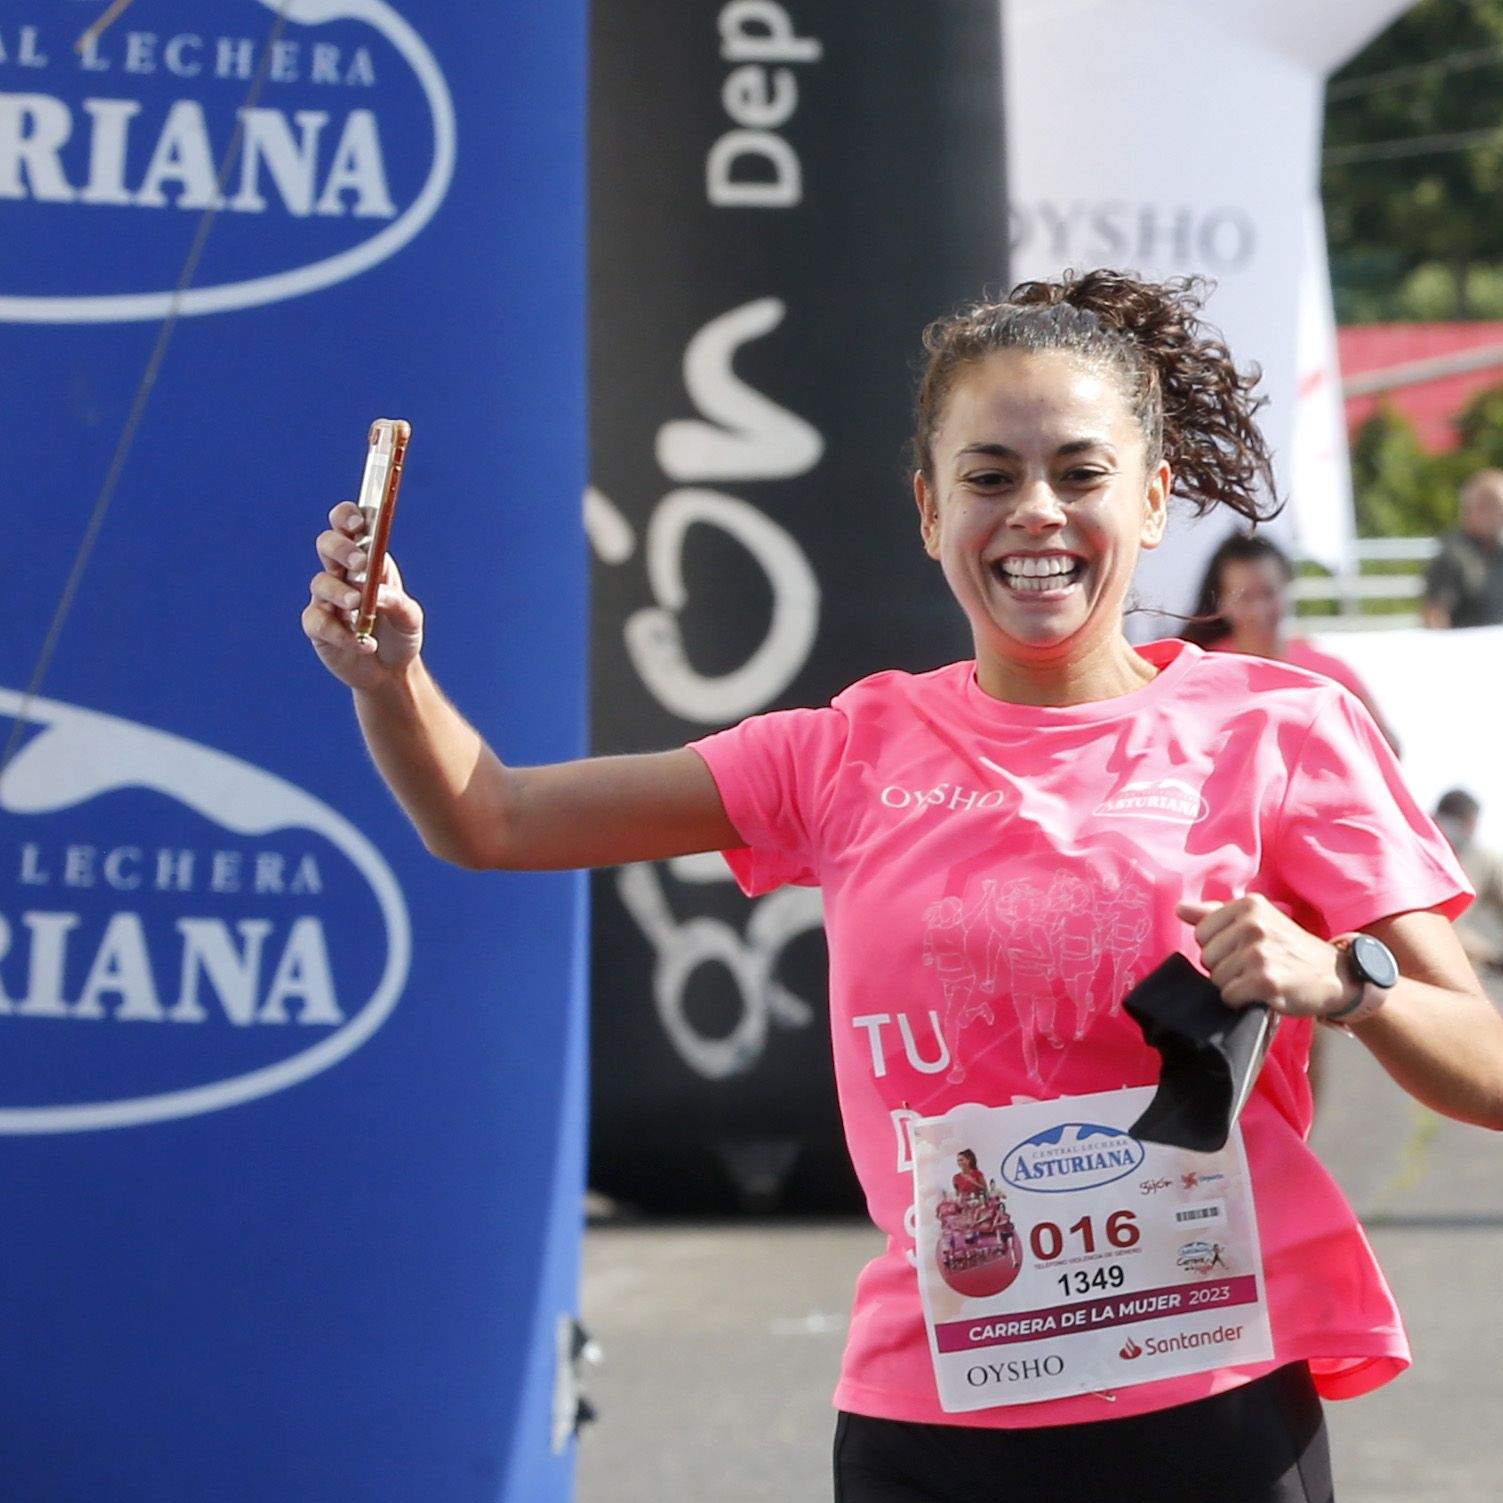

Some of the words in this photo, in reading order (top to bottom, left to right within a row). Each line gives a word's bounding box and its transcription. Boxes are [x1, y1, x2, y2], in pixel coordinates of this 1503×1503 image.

[79, 30, 376, 86] LECHERA
[583, 297, 826, 1078] gón
[881, 783, 1004, 811] OYSHO
[18, 842, 323, 894] LECHERA
[852, 1010, 952, 1078] TU
[1014, 1149, 1135, 1181] ASTURIANA
[1030, 1209, 1140, 1261] 016
[1058, 1265, 1124, 1296] 1349
[969, 1316, 1056, 1341] CARRERA
[1061, 1311, 1085, 1328] DE
[1091, 1303, 1115, 1322] LA
[1119, 1294, 1181, 1317] MUJER
[1188, 1286, 1230, 1306] 2023
[1145, 1324, 1243, 1356] Santander
[967, 1355, 1065, 1387] OYSHO
